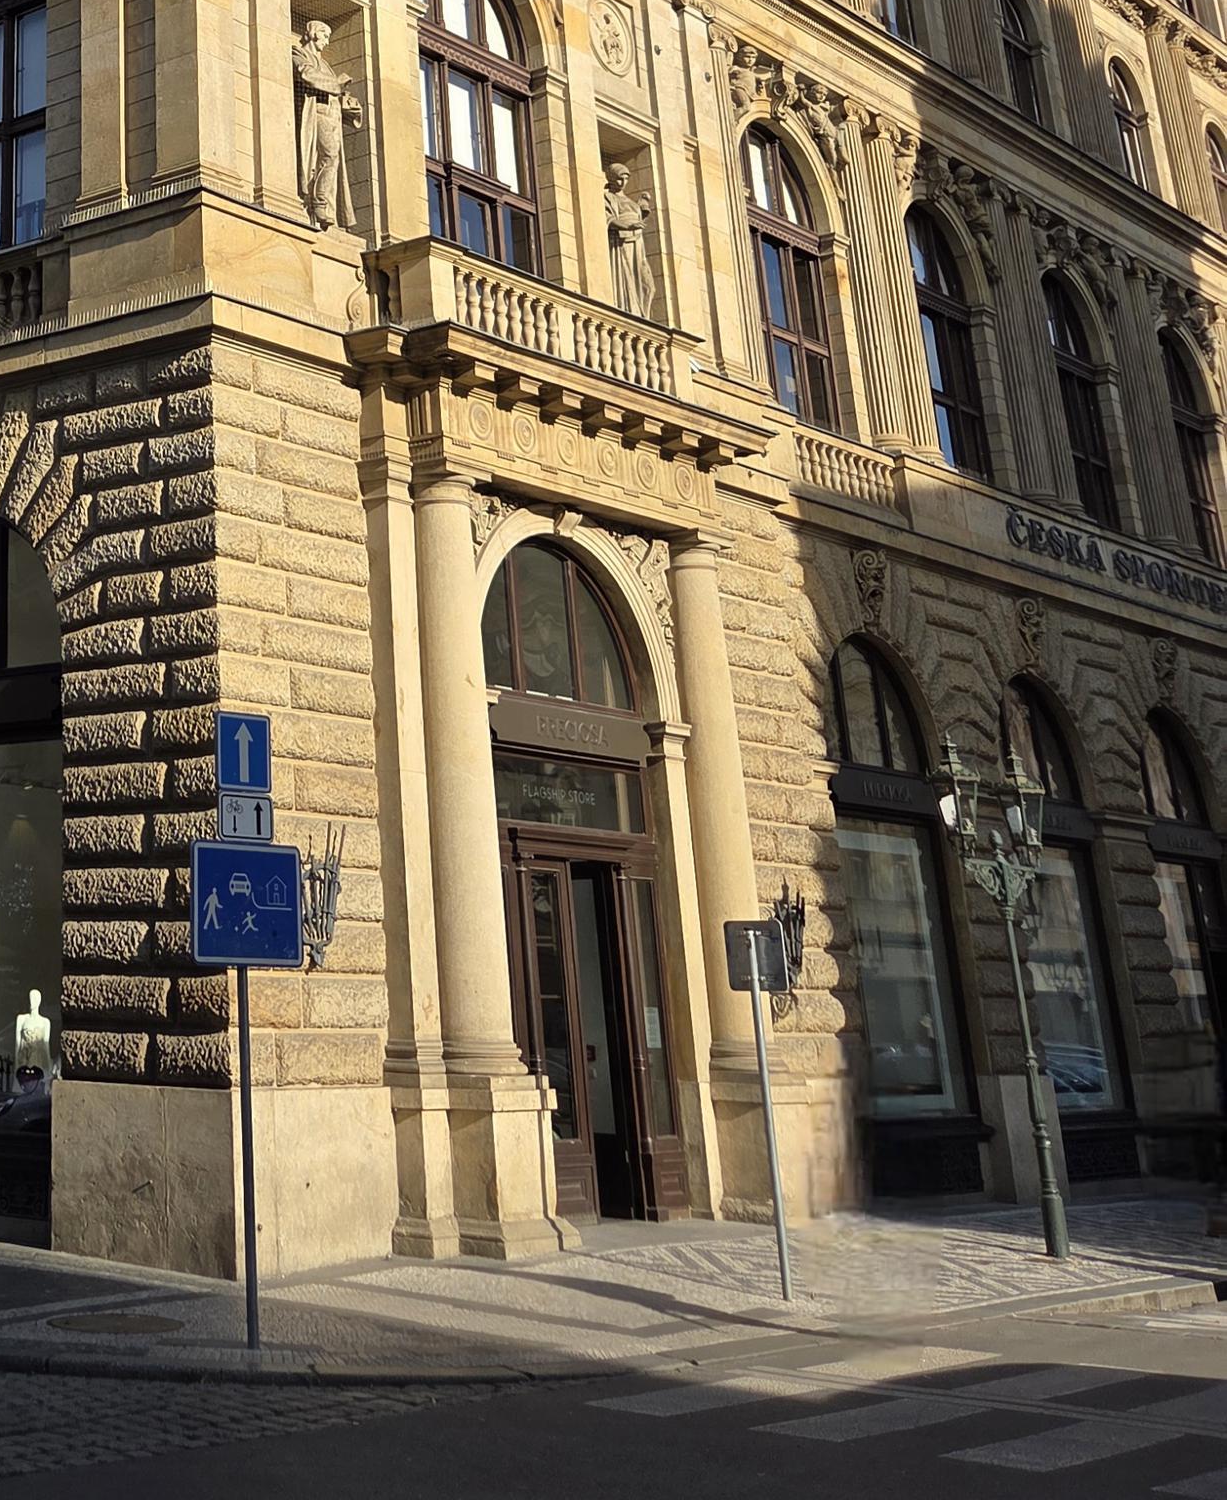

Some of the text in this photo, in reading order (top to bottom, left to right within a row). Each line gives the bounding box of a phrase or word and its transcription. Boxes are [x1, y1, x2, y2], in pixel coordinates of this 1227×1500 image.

[1006, 504, 1227, 615] ČESKÁ SPOŘITE
[535, 715, 609, 747] PRECIOSA
[522, 784, 596, 805] FLAGSHIP STORE
